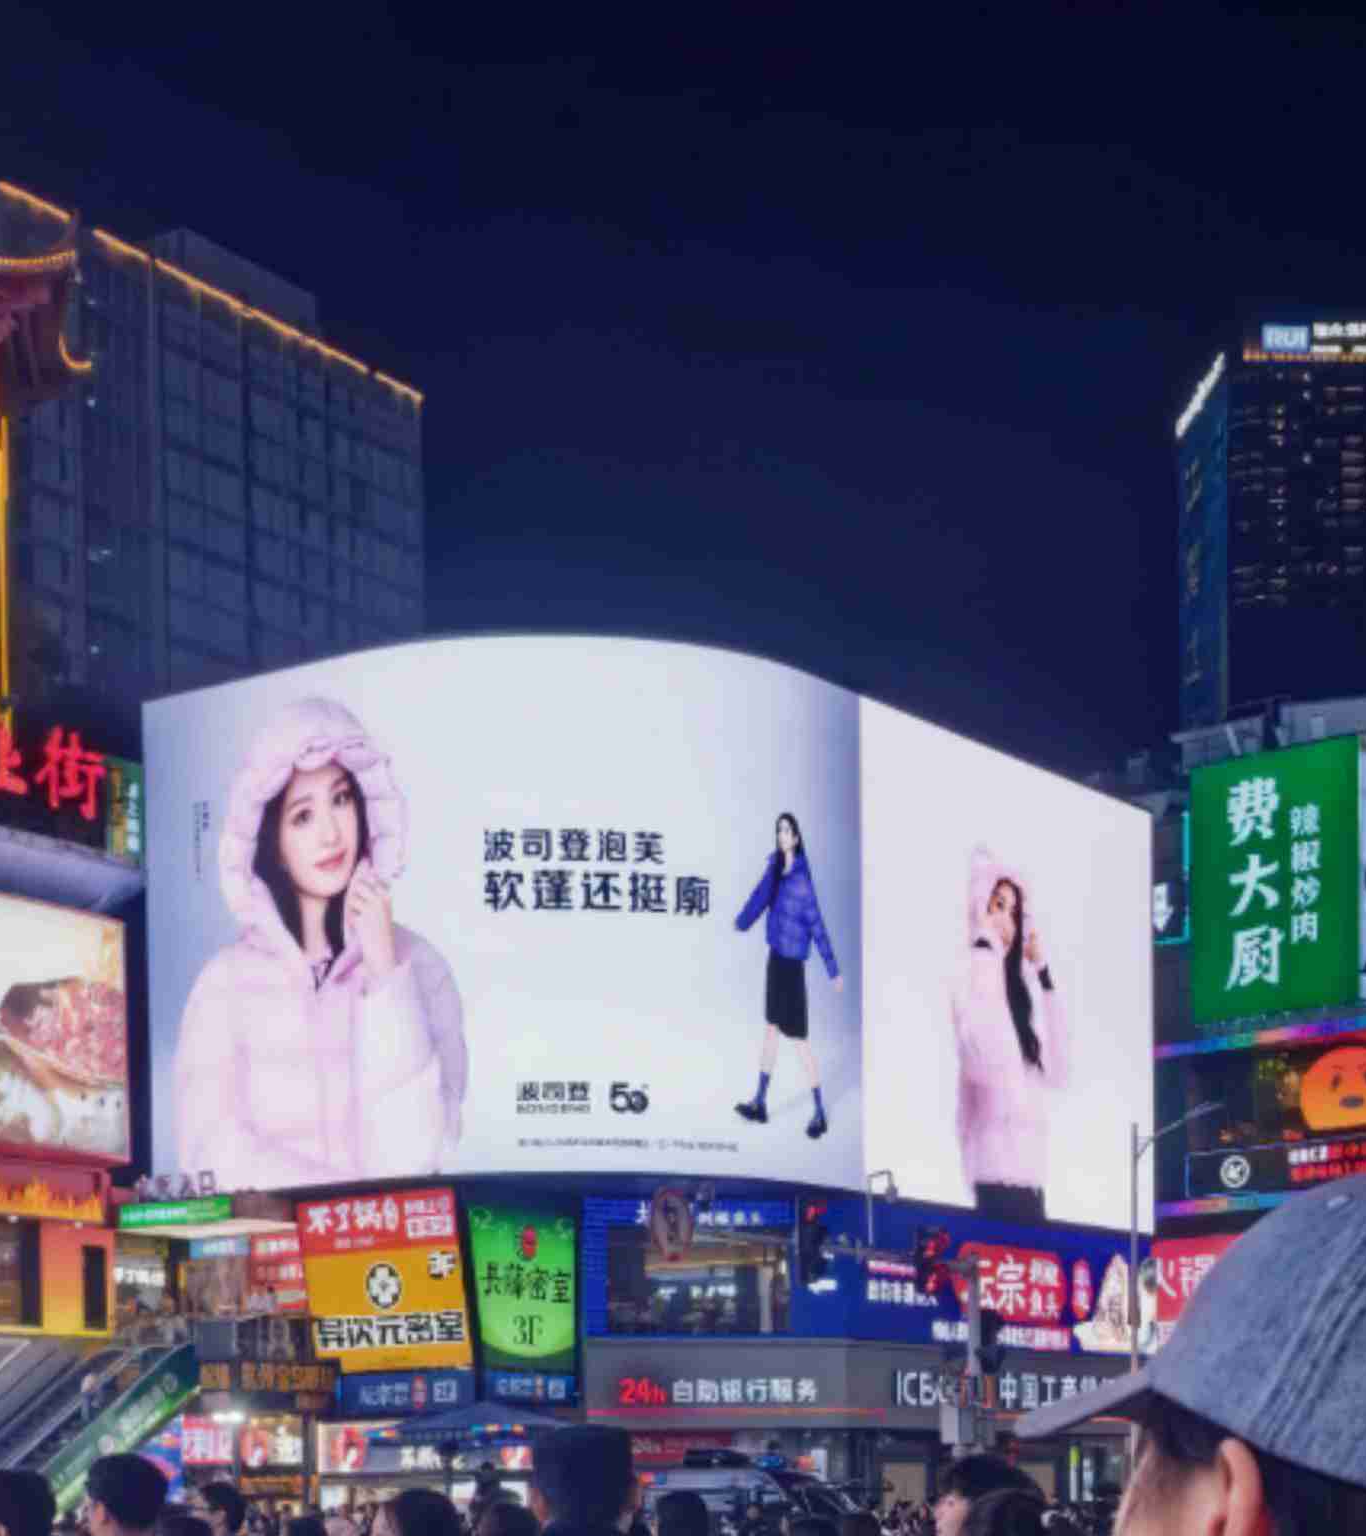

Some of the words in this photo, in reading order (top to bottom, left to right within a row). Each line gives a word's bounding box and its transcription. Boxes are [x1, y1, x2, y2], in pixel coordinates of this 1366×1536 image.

[483, 828, 666, 863] 波司登泡芙
[483, 869, 711, 918] 软蓬还挺廓
[1225, 776, 1285, 992] 费大厨
[1289, 802, 1321, 945] 辣椒炒肉
[316, 1311, 465, 1350] 异次元密室
[619, 1377, 668, 1406] 24h
[672, 1377, 818, 1404] 自助银行服务
